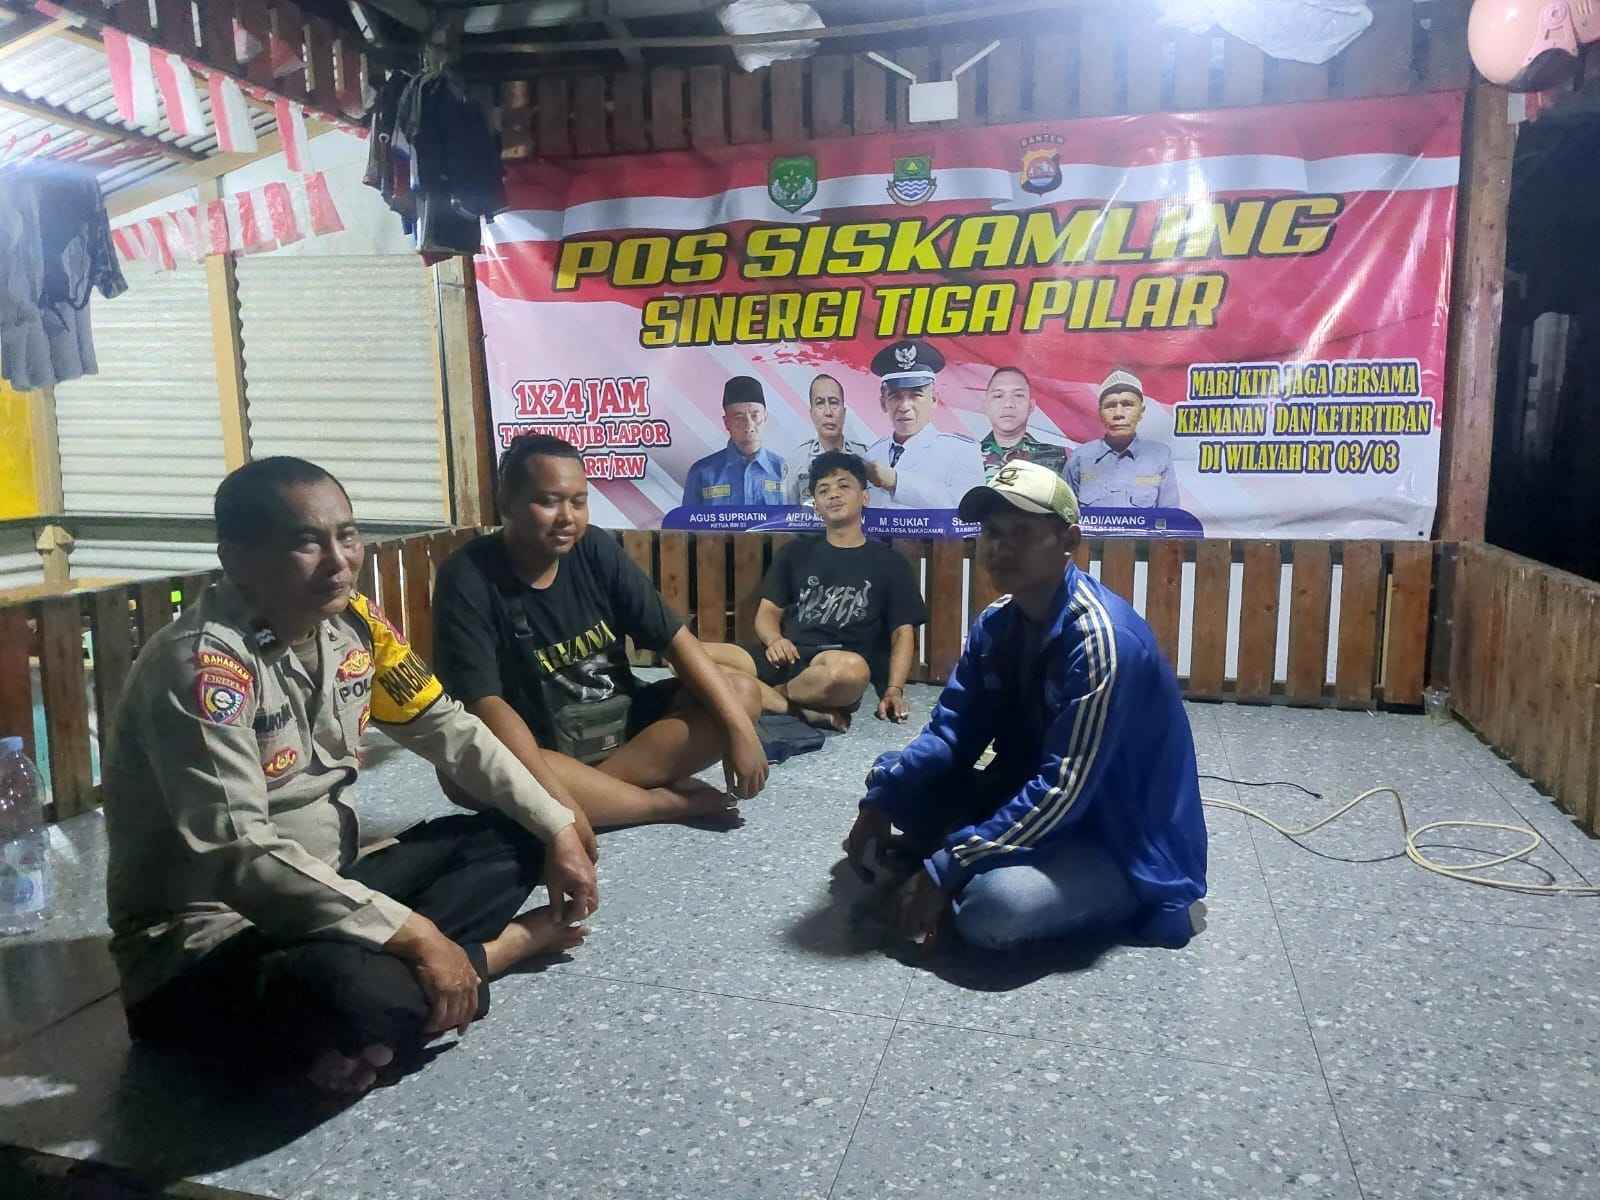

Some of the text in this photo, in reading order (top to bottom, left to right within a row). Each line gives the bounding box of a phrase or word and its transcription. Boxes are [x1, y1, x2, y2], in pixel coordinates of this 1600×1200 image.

[554, 195, 1342, 291] POS SISKAMLING
[640, 272, 1226, 347] SINERGI TIGA PILAR
[1189, 361, 1420, 400] MARI KITA JAGA BERSAMA
[512, 377, 650, 423] 1X24 JAM
[606, 420, 672, 448] LAPOR
[1174, 401, 1434, 436] KEAMANAN DAN KETERTIBAN
[582, 450, 648, 480] RT/RW
[1199, 440, 1401, 473] DI WILAYAH RT 03/03
[689, 512, 767, 522] AGUS SUPRIATIN
[892, 516, 930, 527] SUKIAT
